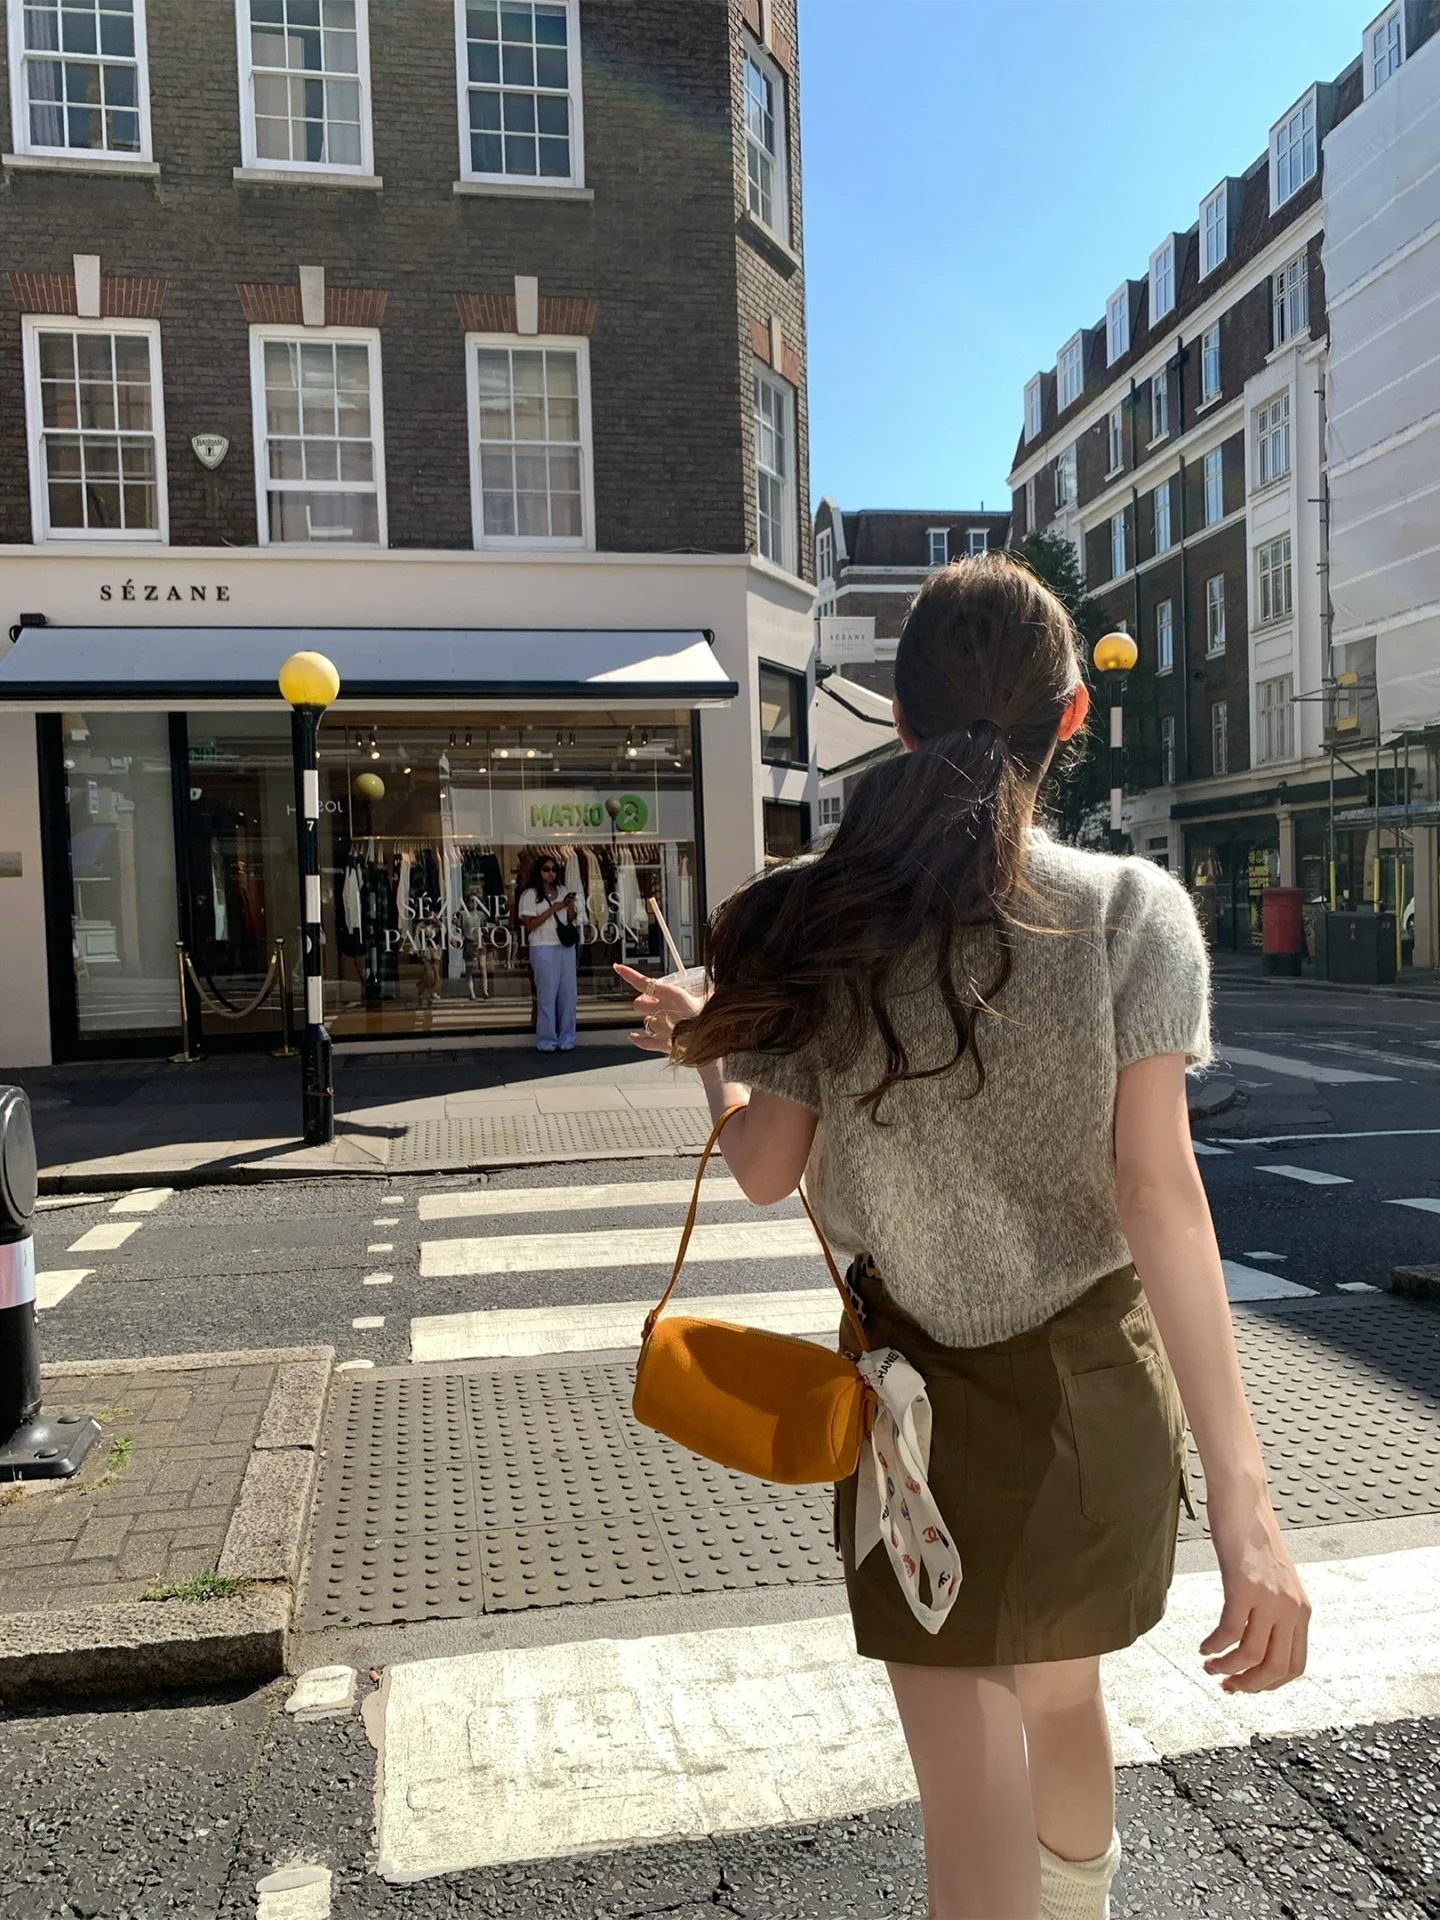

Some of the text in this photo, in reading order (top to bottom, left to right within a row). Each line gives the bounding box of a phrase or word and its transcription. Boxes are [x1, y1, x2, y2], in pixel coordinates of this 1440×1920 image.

[100, 579, 230, 601] SÉZANE
[306, 820, 315, 832] 7
[402, 891, 511, 921] SÉZANE
[384, 926, 464, 953] PARIS
[471, 925, 512, 949] TO
